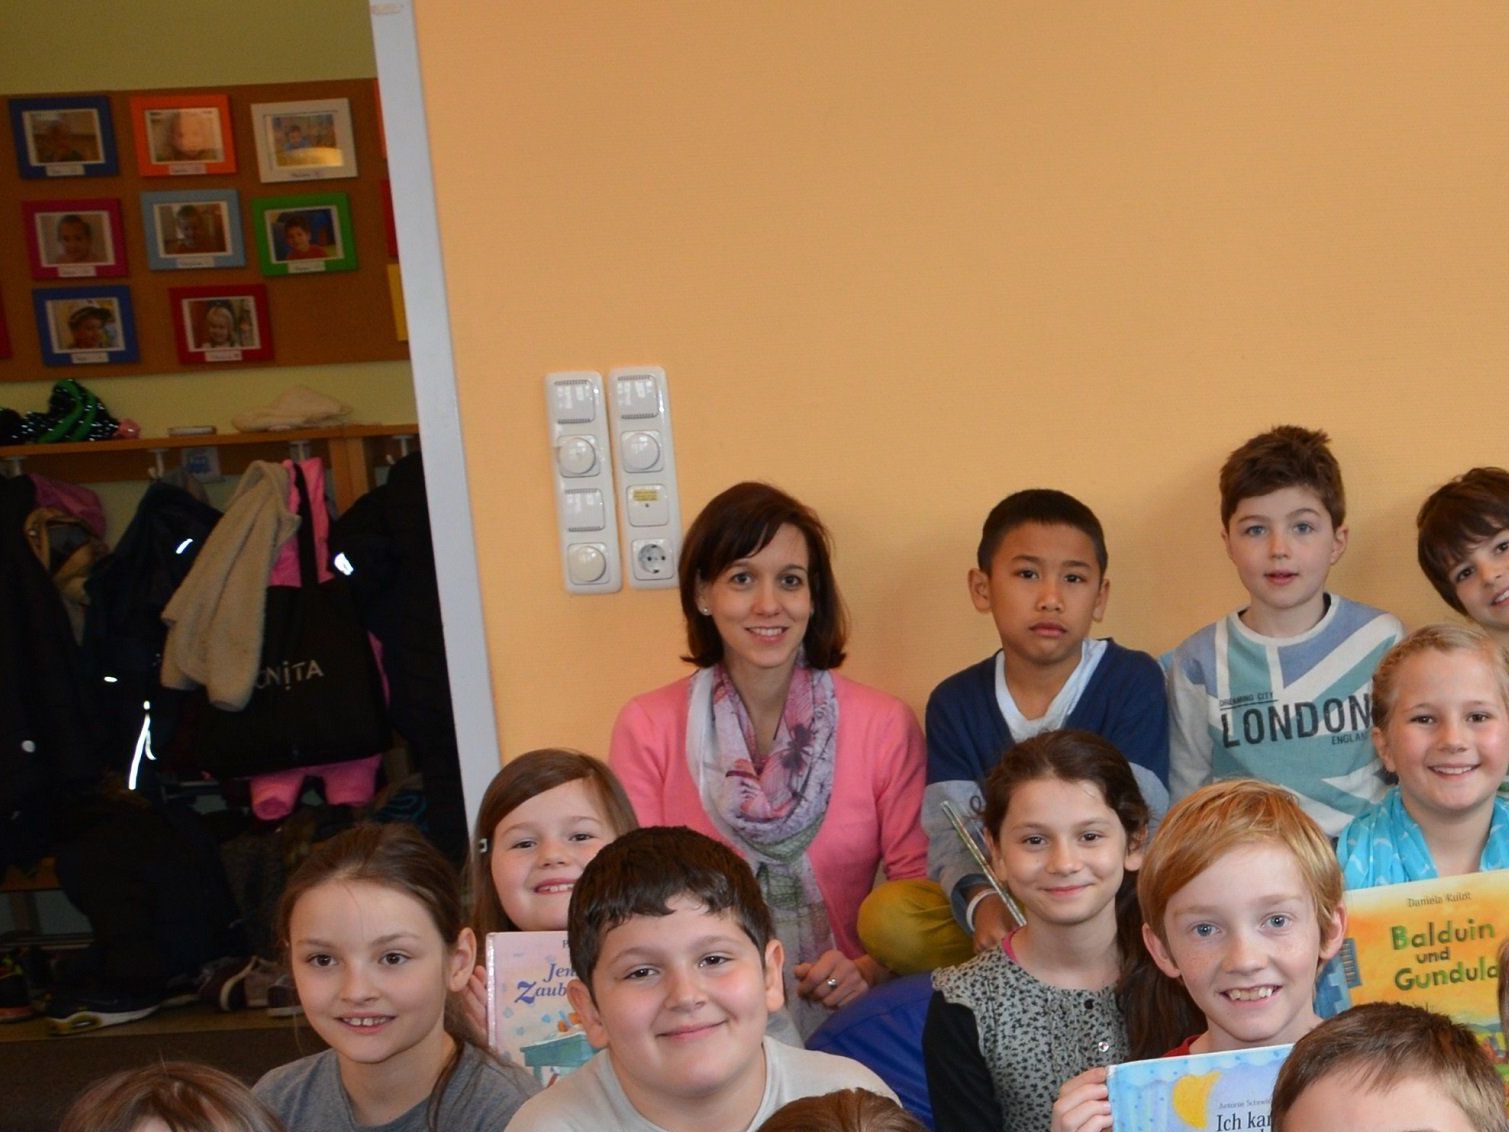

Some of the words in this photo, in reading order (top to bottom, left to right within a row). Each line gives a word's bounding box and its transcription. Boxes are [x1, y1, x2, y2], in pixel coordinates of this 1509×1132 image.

[1221, 692, 1372, 748] LONDON
[1390, 919, 1495, 951] Balduin
[1416, 948, 1450, 964] und
[543, 963, 576, 983] Jen
[1395, 957, 1499, 991] Gundula
[514, 980, 568, 1005] Zaub
[1216, 1113, 1242, 1132] Ich
